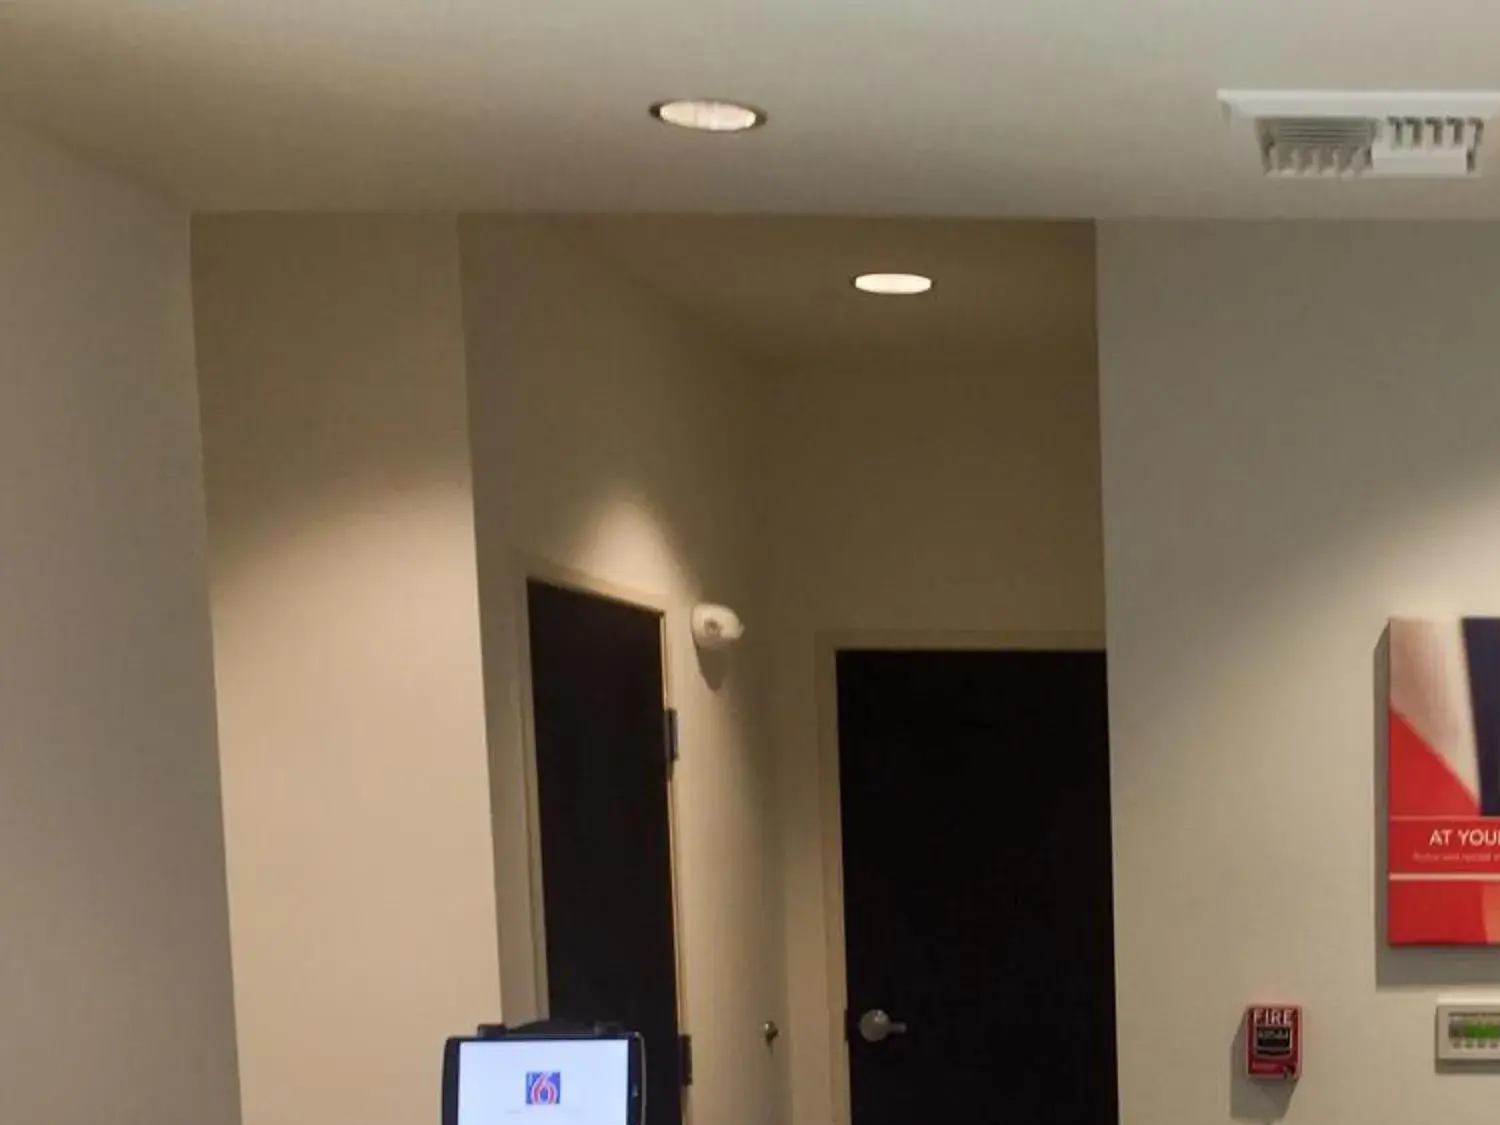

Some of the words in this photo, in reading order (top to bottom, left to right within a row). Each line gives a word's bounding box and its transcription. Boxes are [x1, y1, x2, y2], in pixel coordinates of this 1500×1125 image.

[1428, 828, 1453, 846] AT
[1253, 1008, 1294, 1026] FIRE
[530, 1071, 558, 1104] 6
